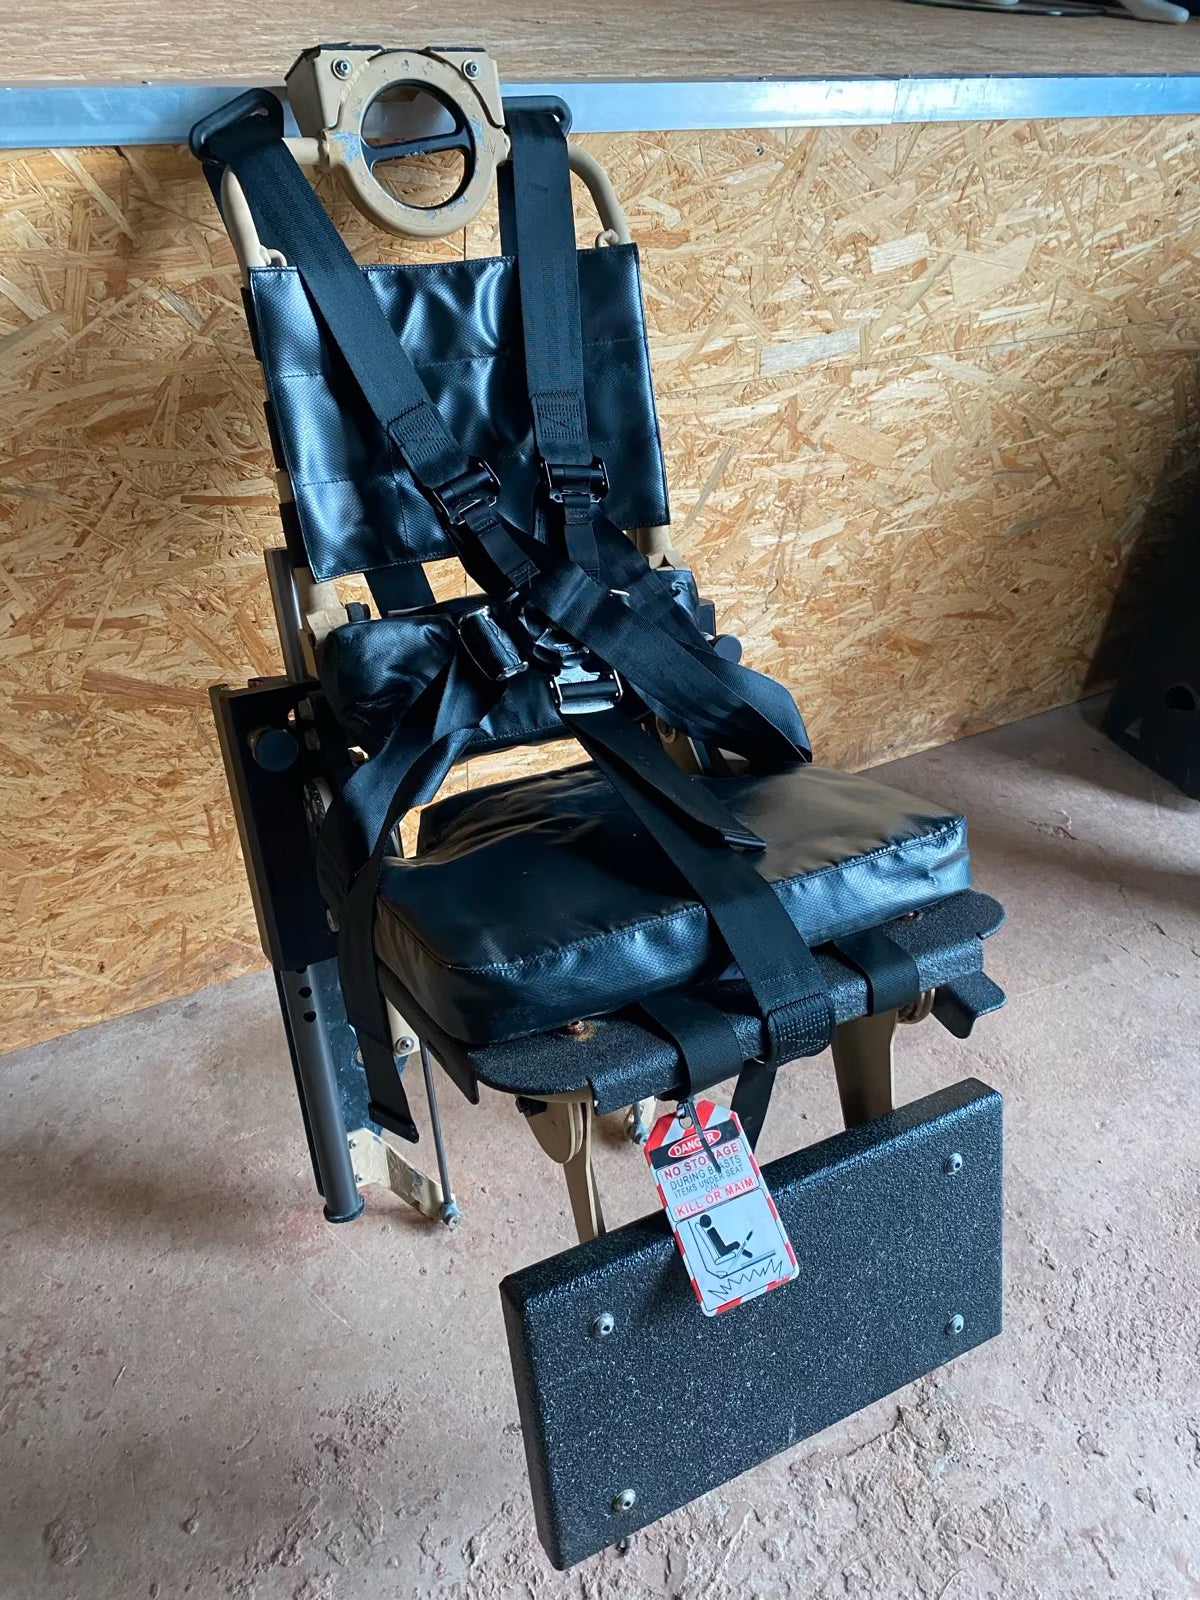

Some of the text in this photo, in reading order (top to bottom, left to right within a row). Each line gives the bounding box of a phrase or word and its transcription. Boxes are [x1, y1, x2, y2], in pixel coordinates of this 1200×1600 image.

[673, 1132, 715, 1156] DANGR
[664, 1167, 681, 1181] NO
[670, 1154, 741, 1191] DURING BASTS
[674, 1165, 743, 1199] ITEMS UNDER SEAT
[677, 1178, 754, 1217] KILL OR MAIM
[706, 1183, 719, 1193] CAN
